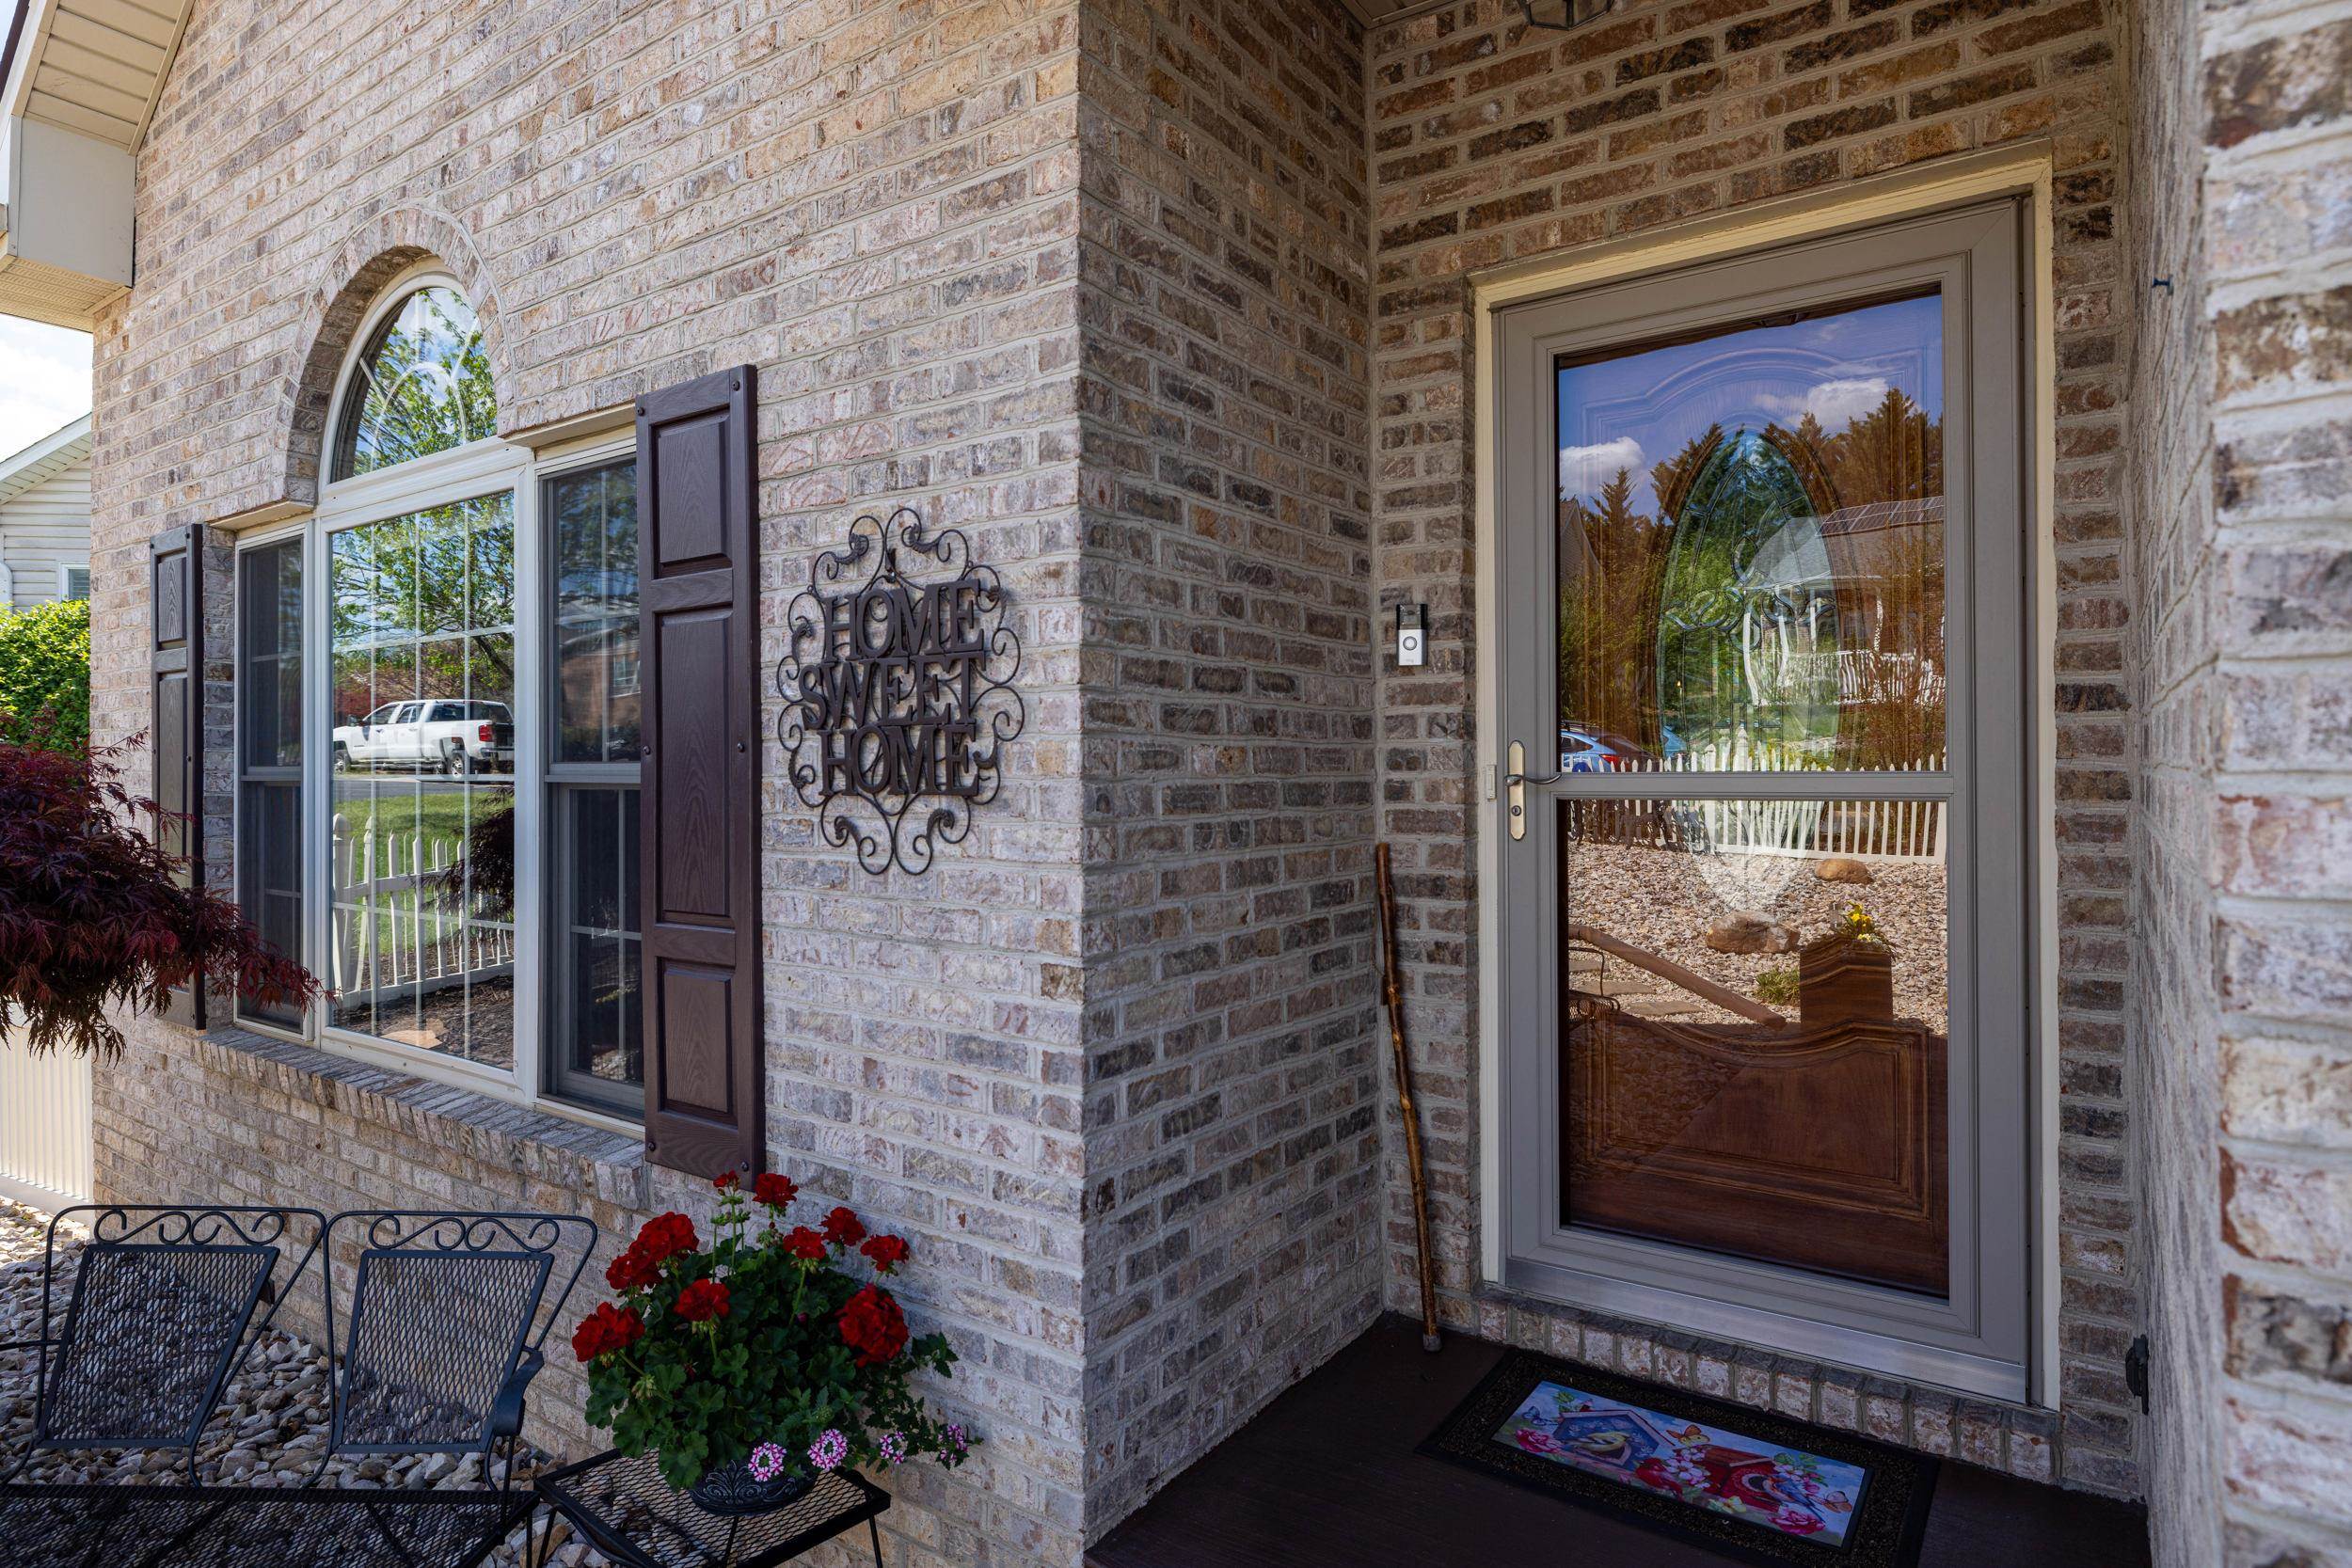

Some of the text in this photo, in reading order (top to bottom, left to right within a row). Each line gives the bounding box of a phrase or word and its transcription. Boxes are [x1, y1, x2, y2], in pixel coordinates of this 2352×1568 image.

[821, 578, 984, 659] HOME
[798, 651, 986, 730] SWEET
[818, 722, 979, 796] HOME
